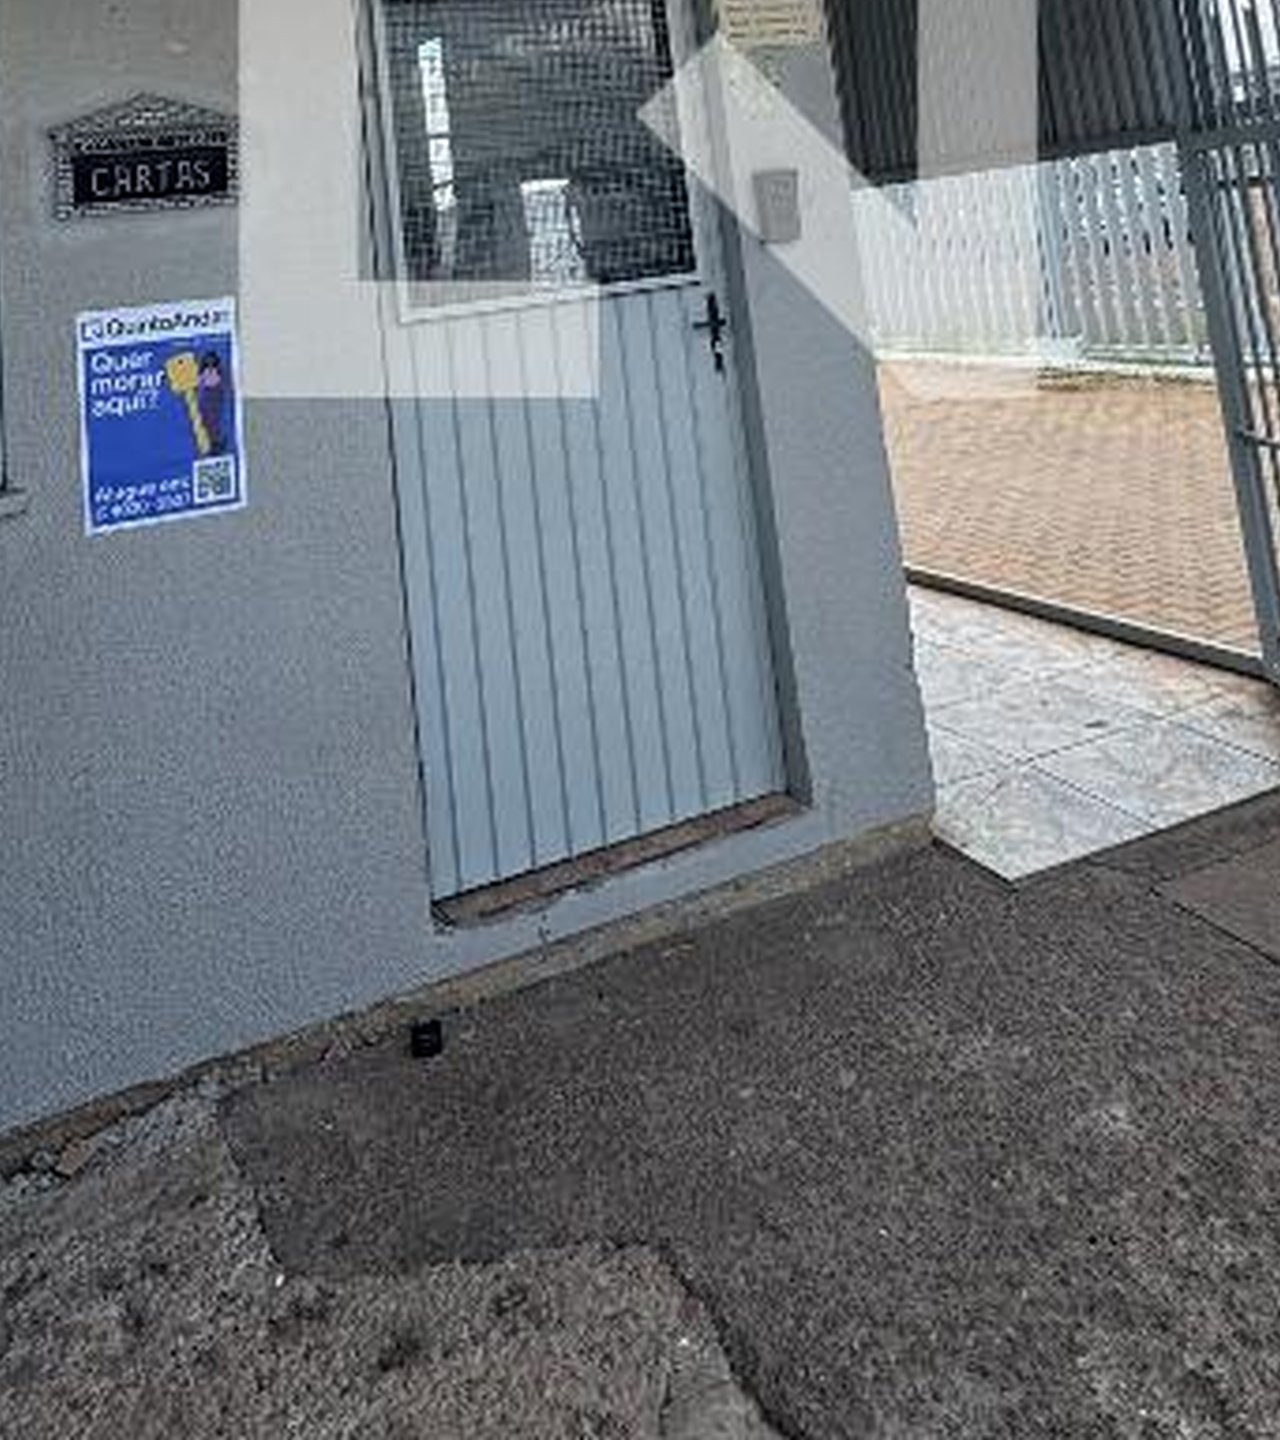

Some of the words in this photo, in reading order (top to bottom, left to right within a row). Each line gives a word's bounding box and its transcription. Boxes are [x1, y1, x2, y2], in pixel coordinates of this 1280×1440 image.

[91, 161, 210, 196] CARTAS
[91, 351, 153, 374] Quer
[91, 370, 165, 395] morar
[91, 389, 159, 417] aqui?
